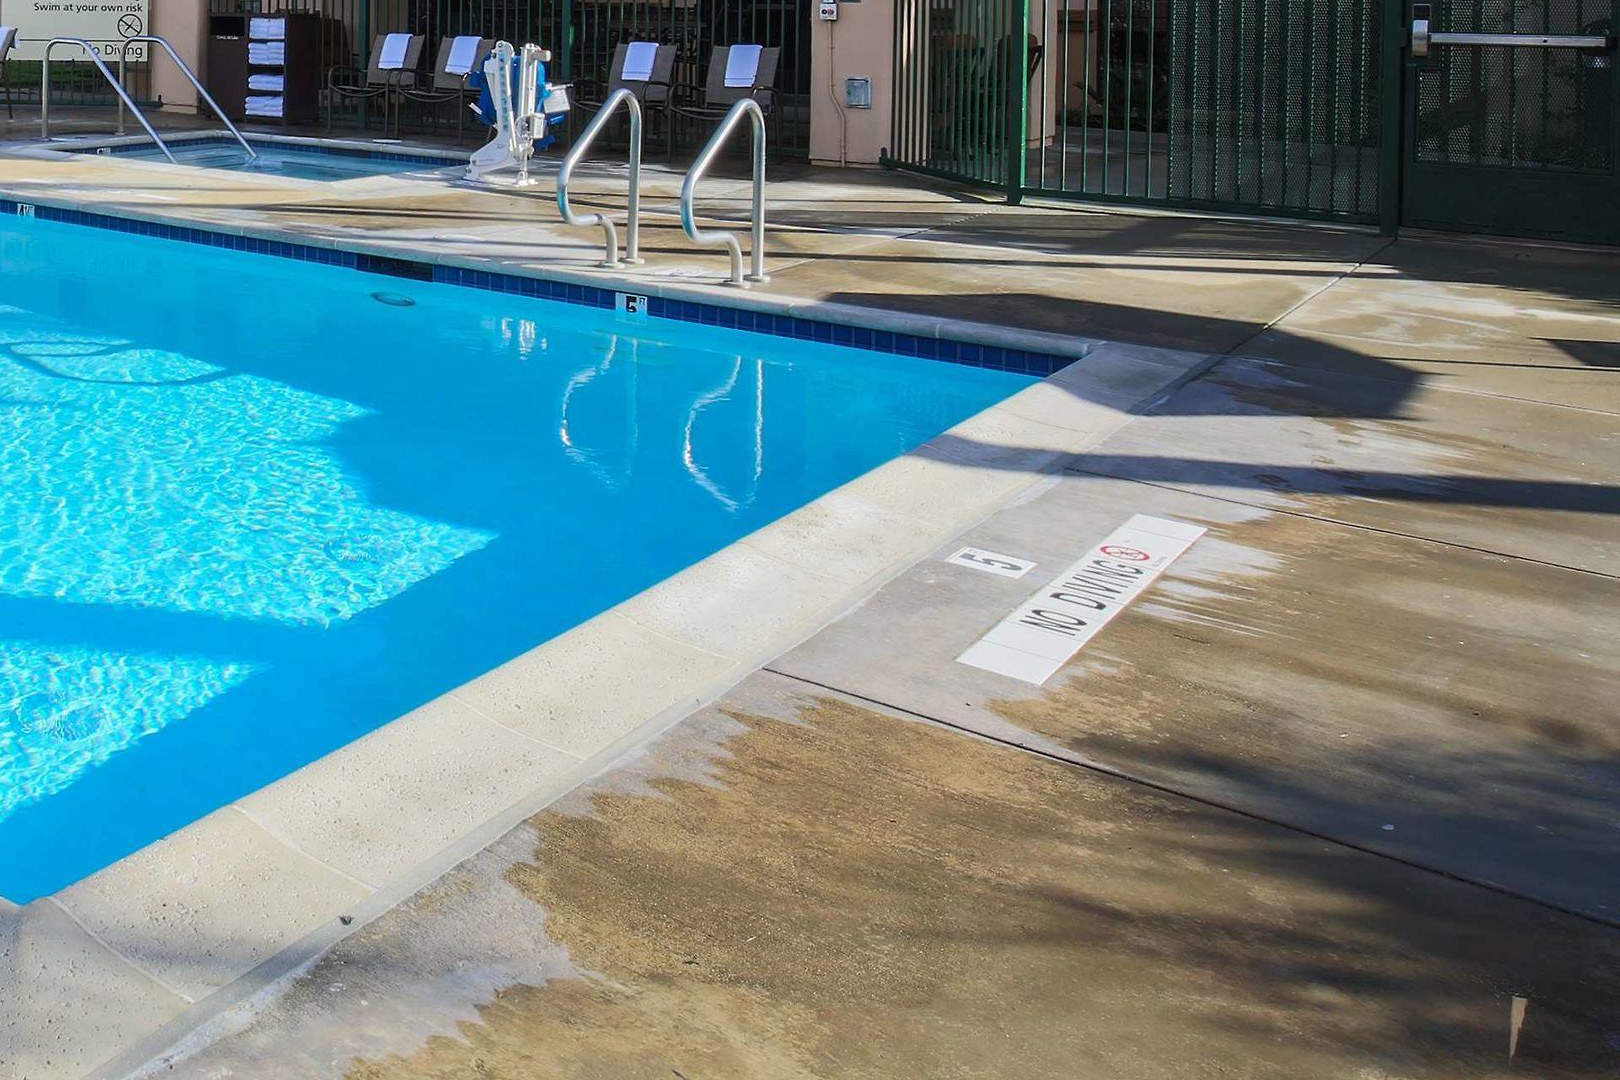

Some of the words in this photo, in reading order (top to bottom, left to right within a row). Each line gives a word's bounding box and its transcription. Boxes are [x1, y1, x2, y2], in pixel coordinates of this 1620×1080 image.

[34, 3, 61, 12] Swim
[63, 4, 74, 12] at
[76, 5, 99, 13] your
[126, 3, 143, 12] risk
[104, 44, 143, 59] Ding
[626, 295, 637, 313] 5
[958, 552, 1023, 571] 5
[1049, 559, 1144, 611] DIVING
[1019, 609, 1088, 637] NO
